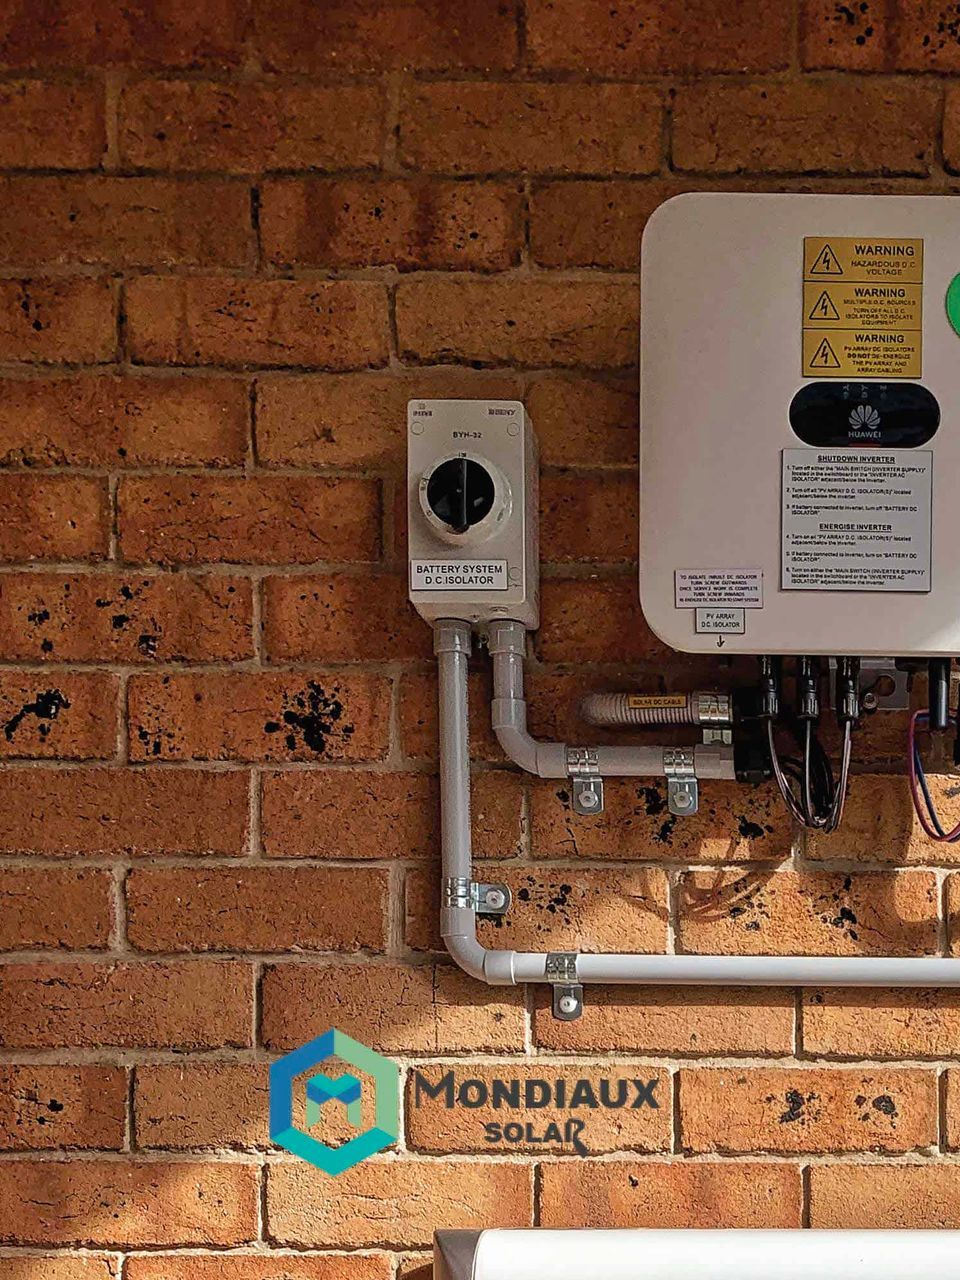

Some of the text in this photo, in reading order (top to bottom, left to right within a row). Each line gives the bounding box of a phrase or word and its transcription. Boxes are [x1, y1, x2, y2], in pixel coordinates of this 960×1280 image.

[855, 245, 914, 256] WARNING
[851, 260, 900, 268] HAZARDOUS
[854, 288, 905, 297] WARNING
[855, 334, 905, 343] WARNING
[818, 455, 859, 463] SHUTDOWN
[820, 523, 855, 531] ENERGISE
[416, 565, 502, 573] BATTERY SYSTEM
